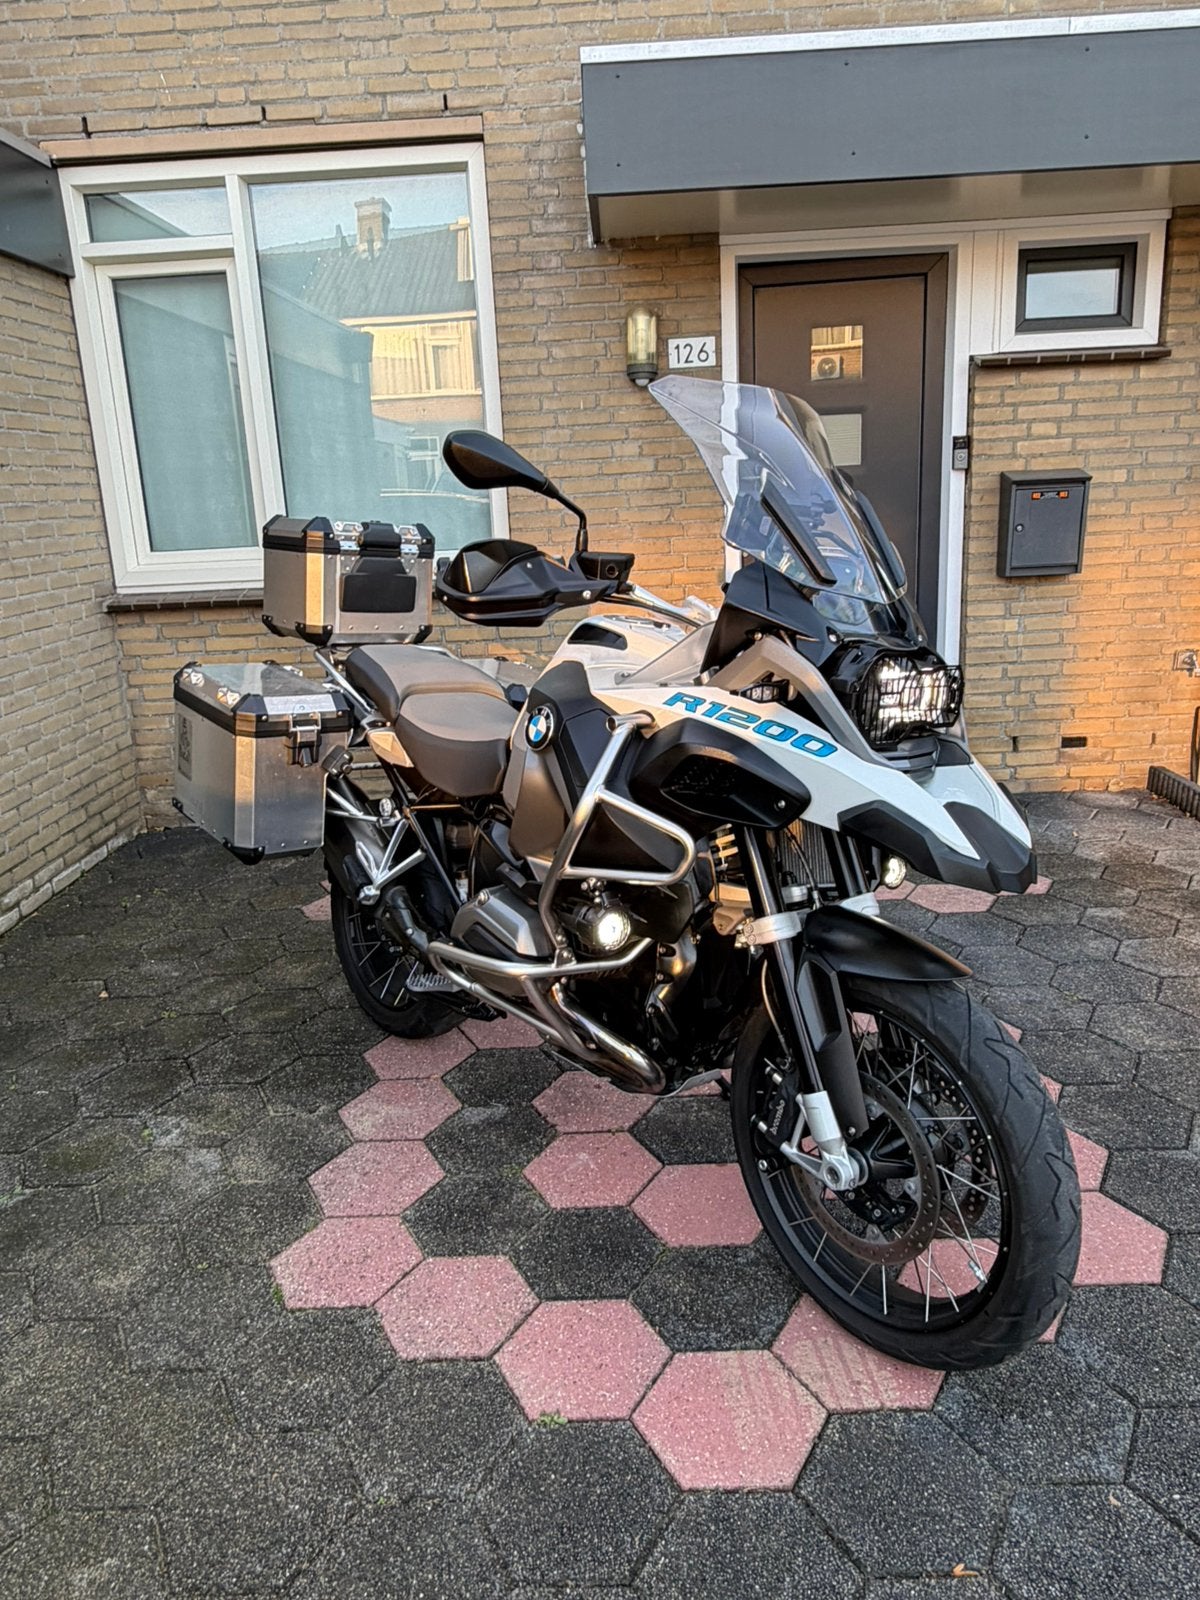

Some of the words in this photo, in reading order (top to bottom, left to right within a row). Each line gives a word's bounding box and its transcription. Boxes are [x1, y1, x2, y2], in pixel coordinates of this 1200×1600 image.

[674, 342, 709, 365] 126
[663, 691, 838, 758] R1200
[769, 1099, 786, 1136] brembo
